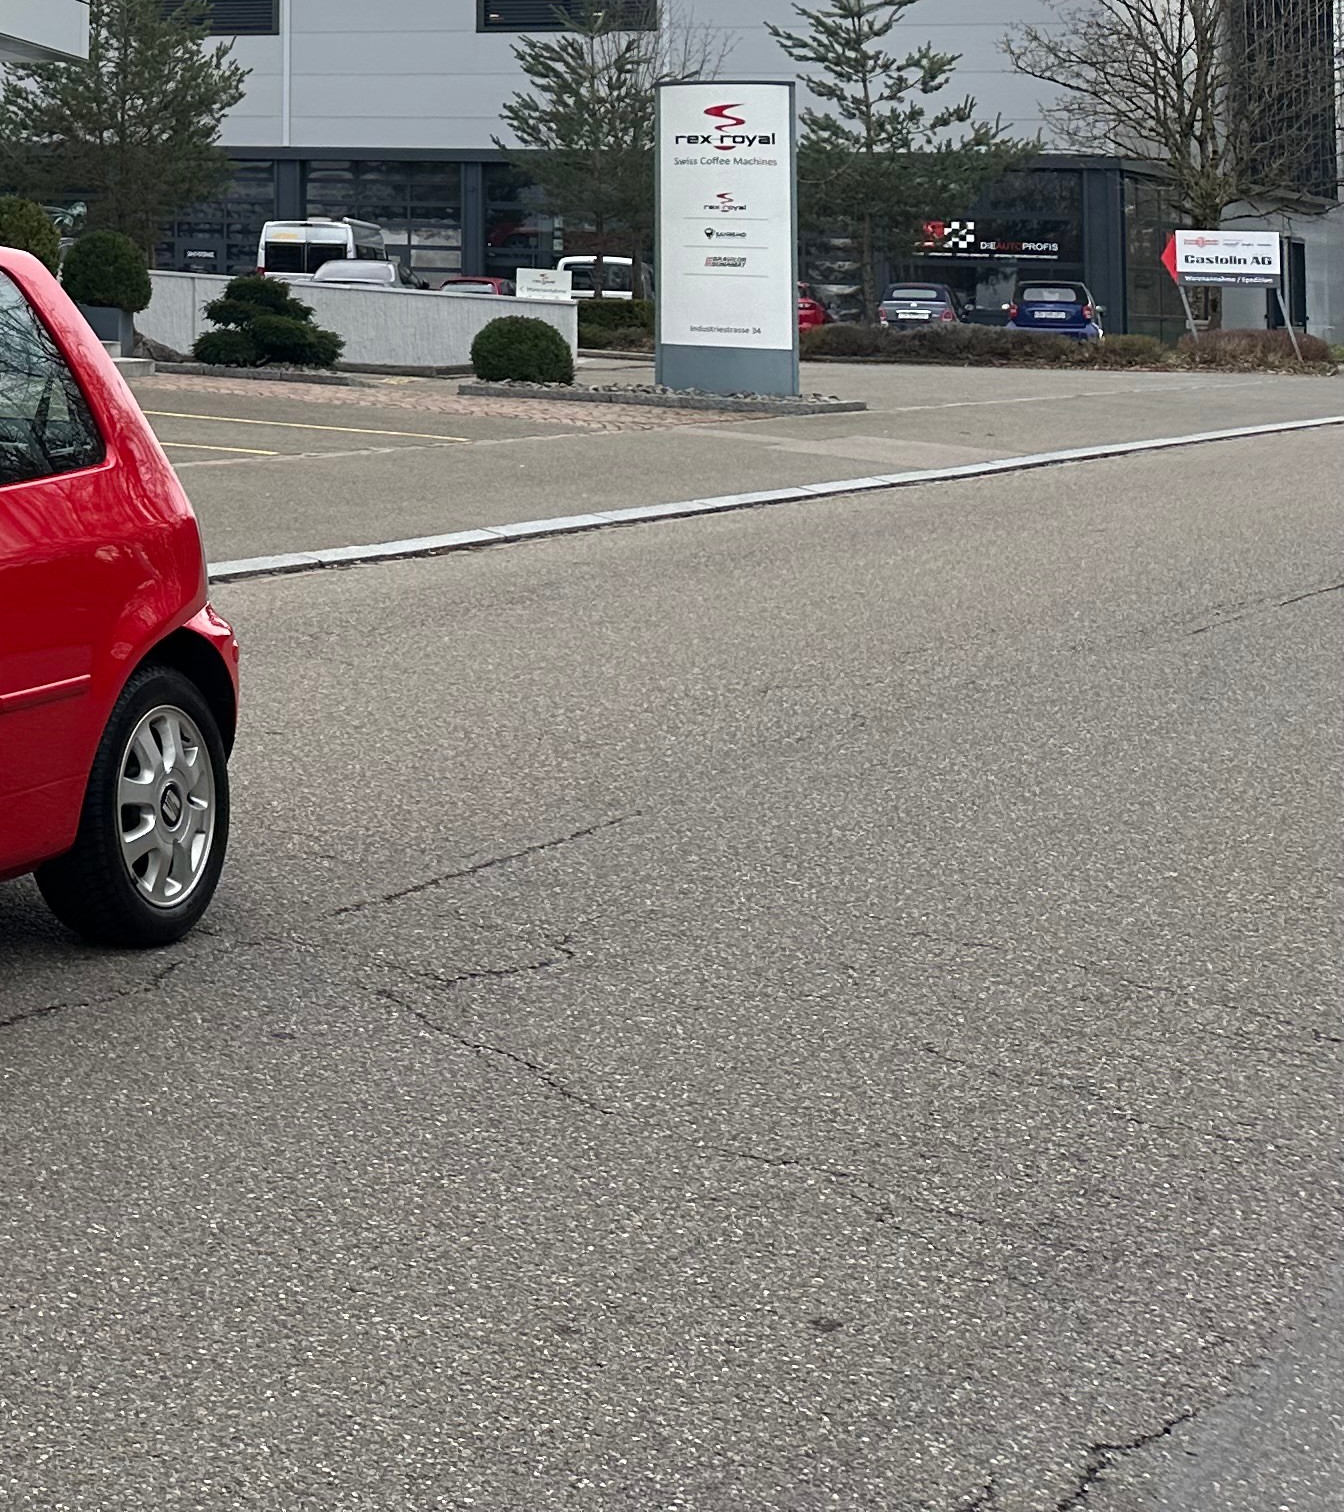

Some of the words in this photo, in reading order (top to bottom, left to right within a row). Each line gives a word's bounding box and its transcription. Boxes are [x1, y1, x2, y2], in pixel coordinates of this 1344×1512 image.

[675, 134, 712, 145] rex
[720, 132, 776, 147] royal
[674, 157, 698, 166] Swiss
[700, 156, 730, 165] Coffee
[733, 157, 778, 167] Machines
[1184, 254, 1247, 265] Castolin
[1251, 256, 1273, 266] AG
